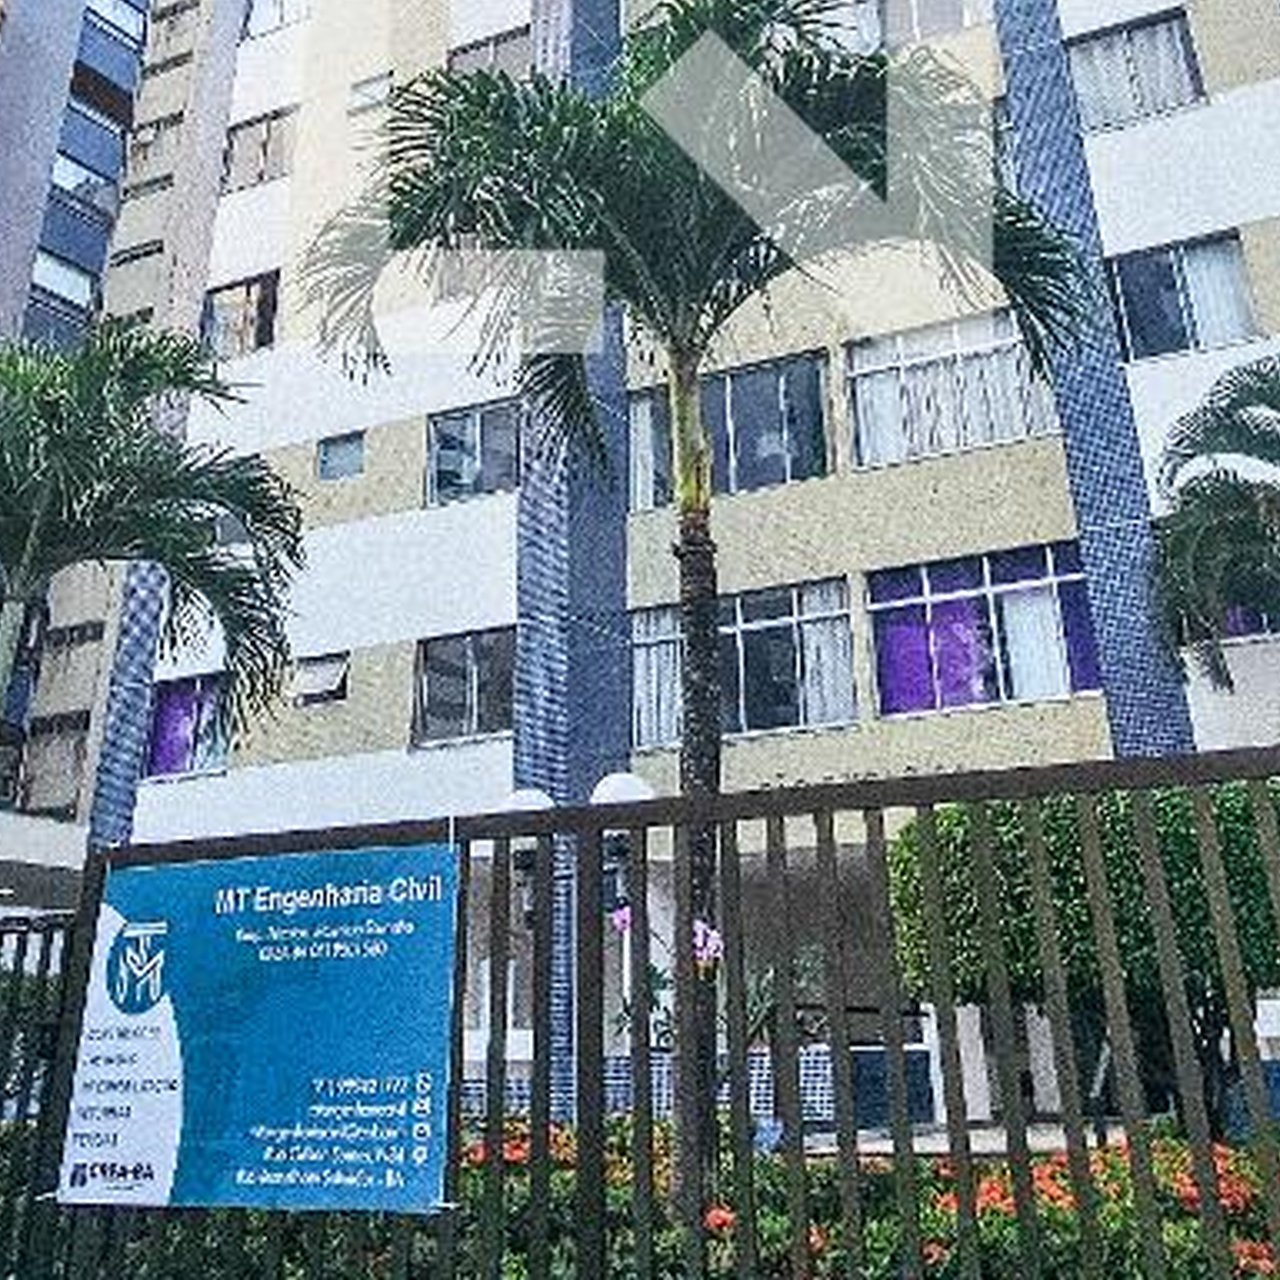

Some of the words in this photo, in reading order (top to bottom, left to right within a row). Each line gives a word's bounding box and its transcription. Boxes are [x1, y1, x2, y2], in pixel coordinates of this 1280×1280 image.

[215, 887, 250, 914] MT
[253, 879, 383, 915] Engenharia
[389, 875, 442, 903] Civil
